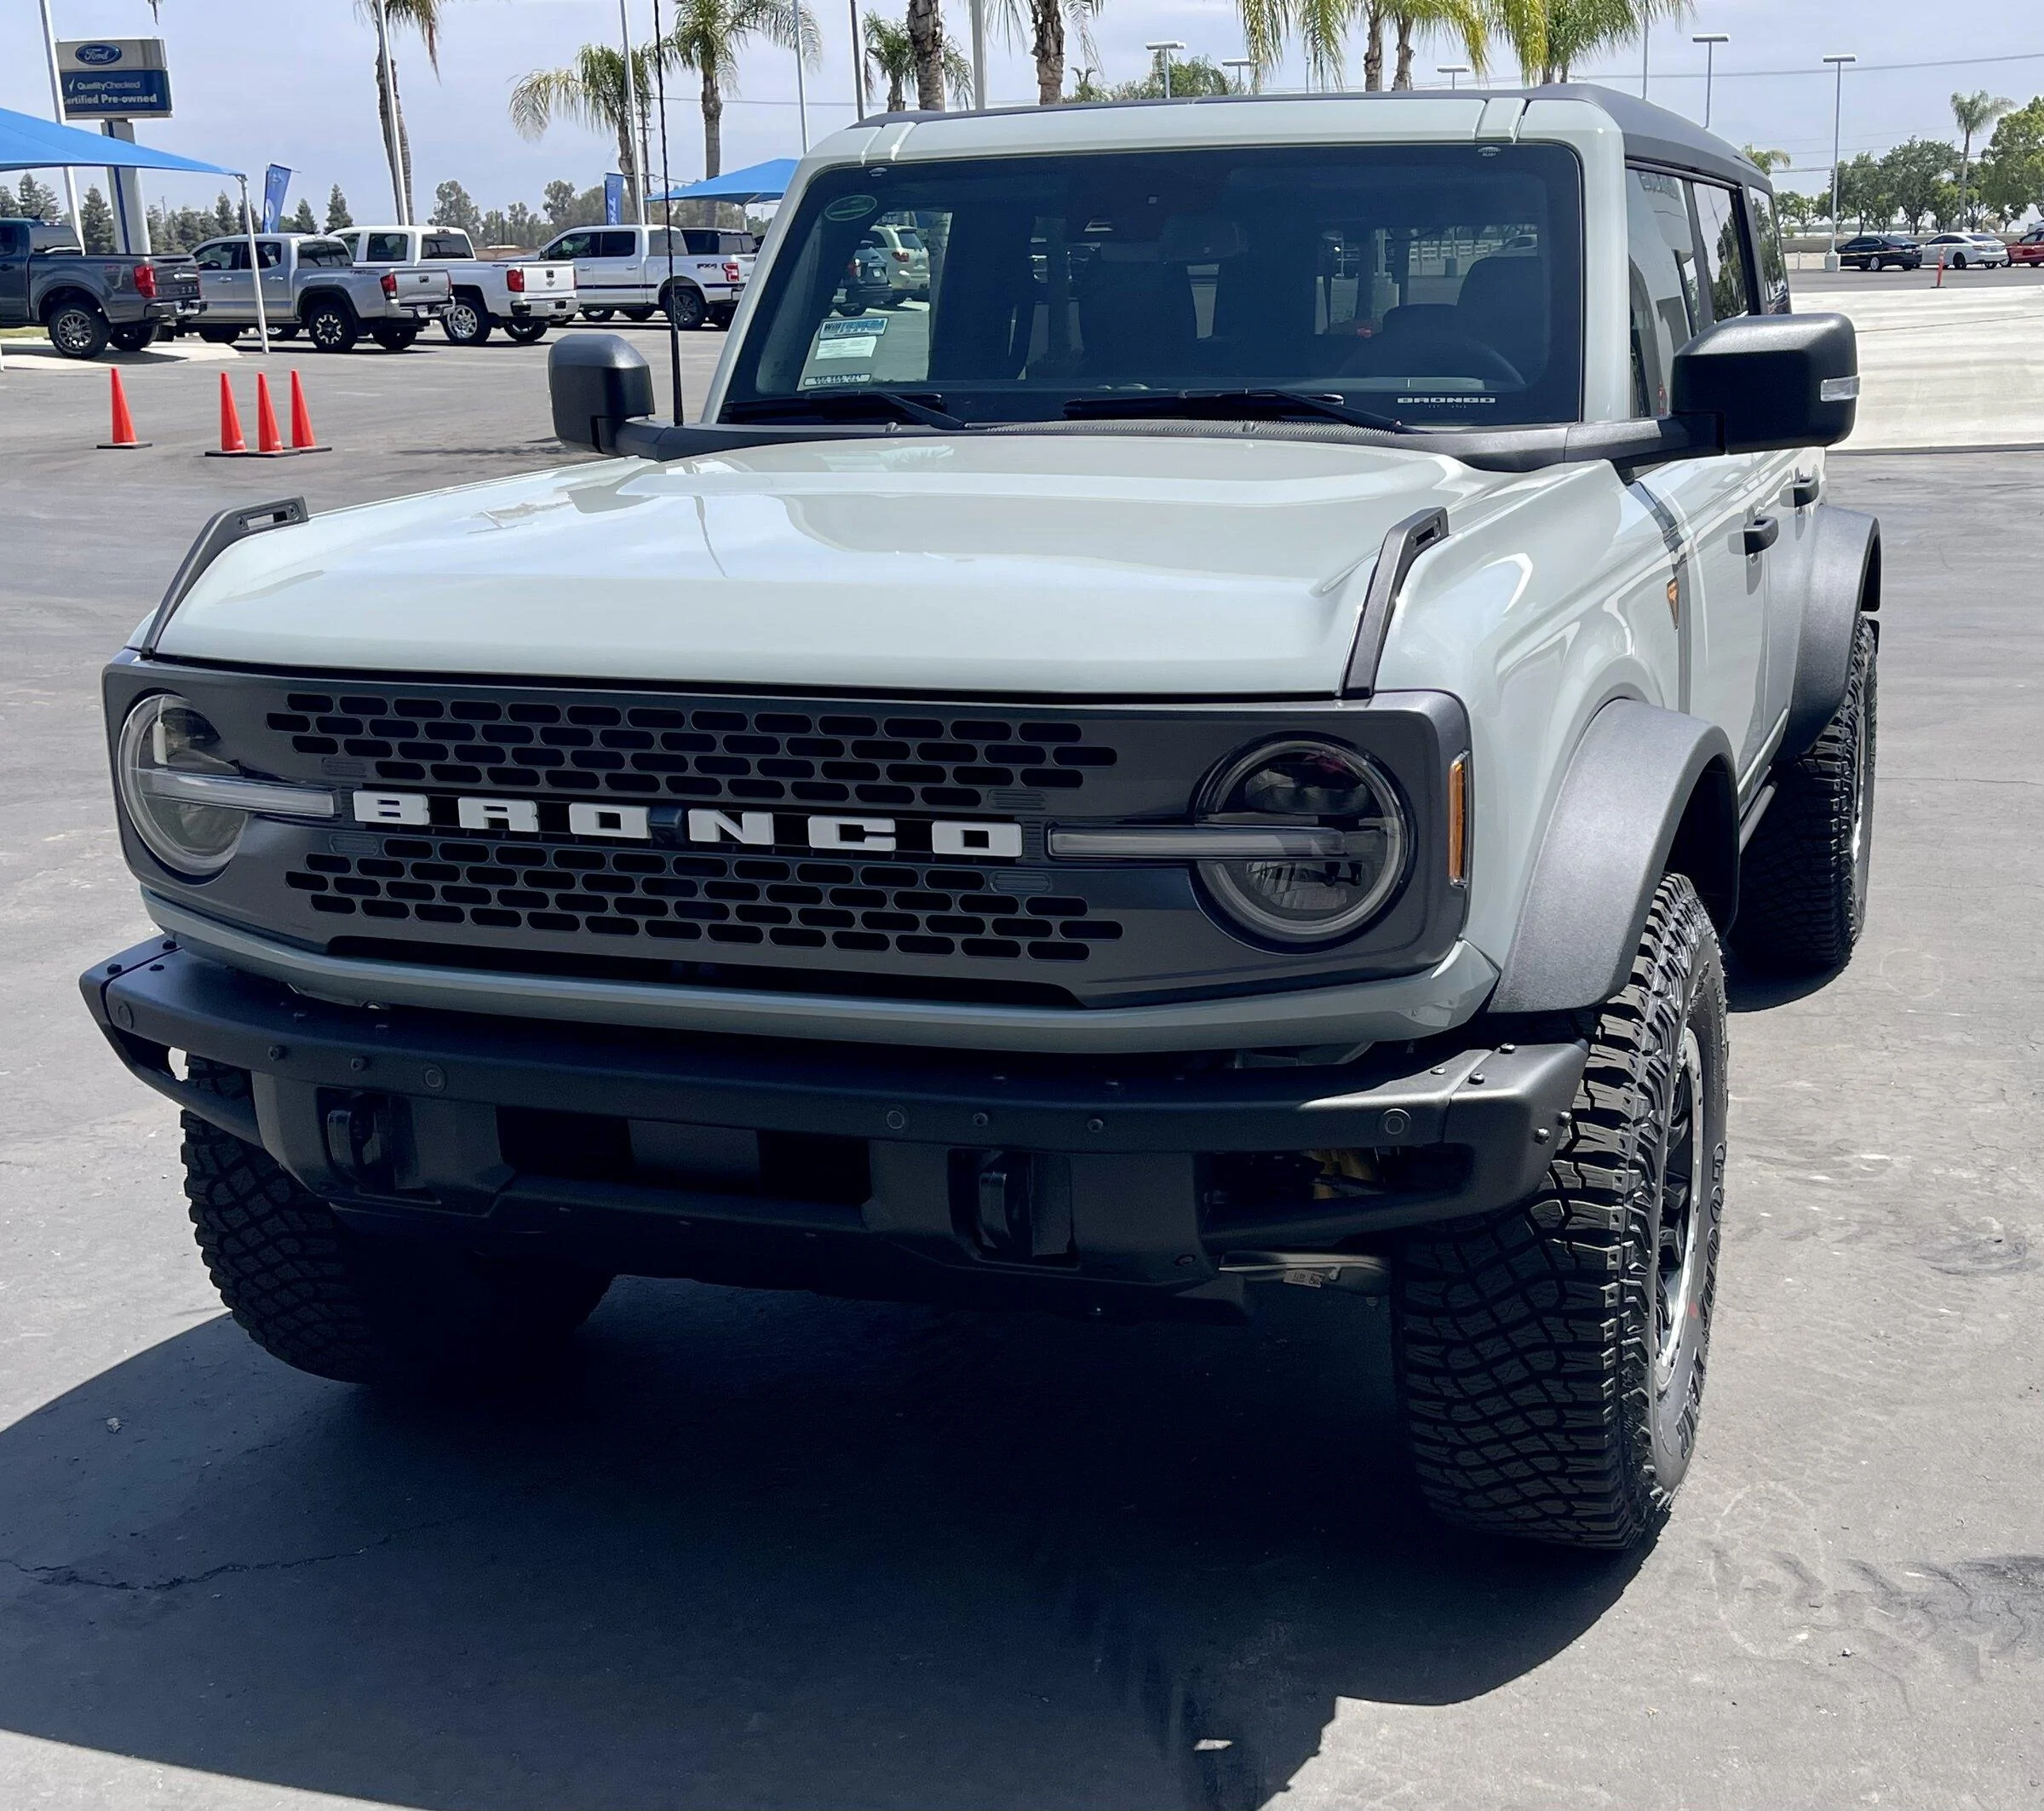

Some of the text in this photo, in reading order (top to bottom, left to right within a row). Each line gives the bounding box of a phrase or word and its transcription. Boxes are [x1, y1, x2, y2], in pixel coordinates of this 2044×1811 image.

[84, 48, 110, 60] Ford
[100, 93, 158, 105] Pre-owned
[352, 789, 1023, 857] BRONCO
